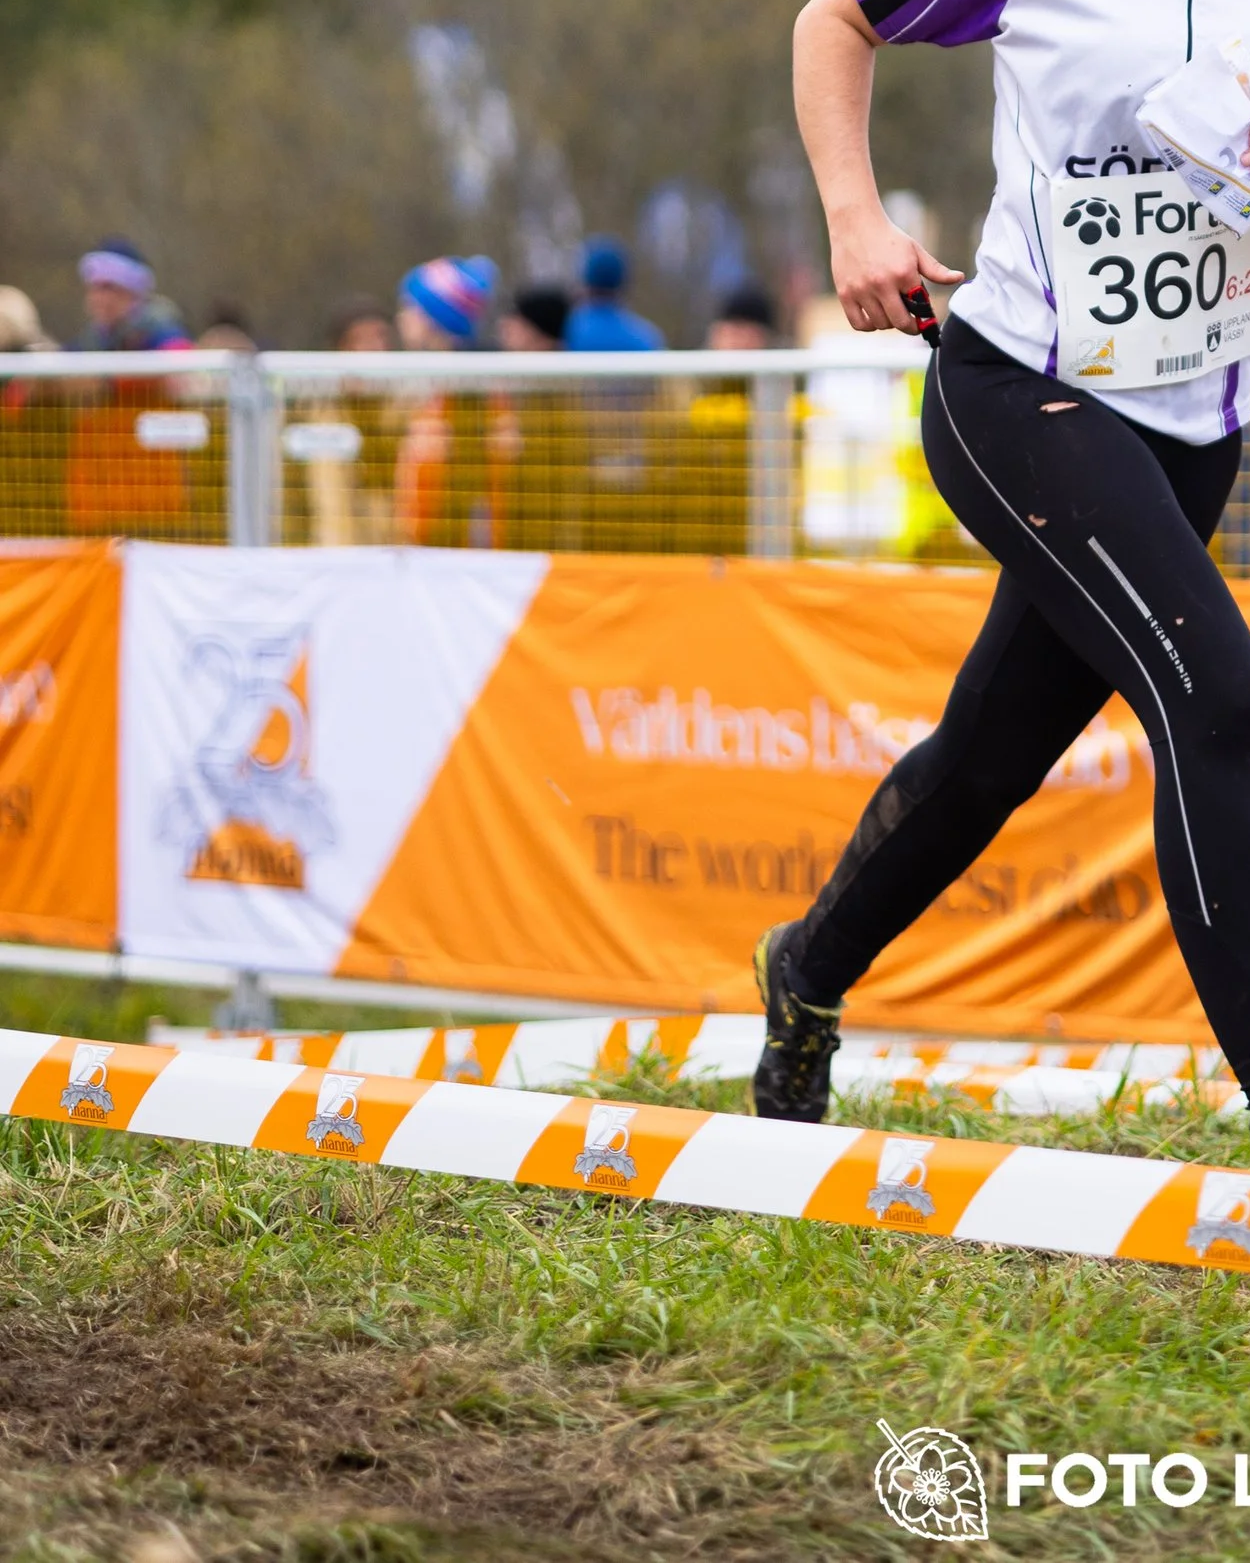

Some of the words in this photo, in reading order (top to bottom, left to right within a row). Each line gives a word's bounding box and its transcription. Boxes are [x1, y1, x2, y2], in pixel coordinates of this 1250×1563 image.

[1088, 243, 1226, 325] 360
[570, 686, 812, 772] Världens
[583, 813, 690, 886] The
[73, 1046, 109, 1089] 25
[70, 1105, 106, 1120] manna
[320, 1076, 360, 1121] 25
[318, 1138, 356, 1154] manna
[589, 1107, 632, 1154] 25
[587, 1171, 628, 1188] manna
